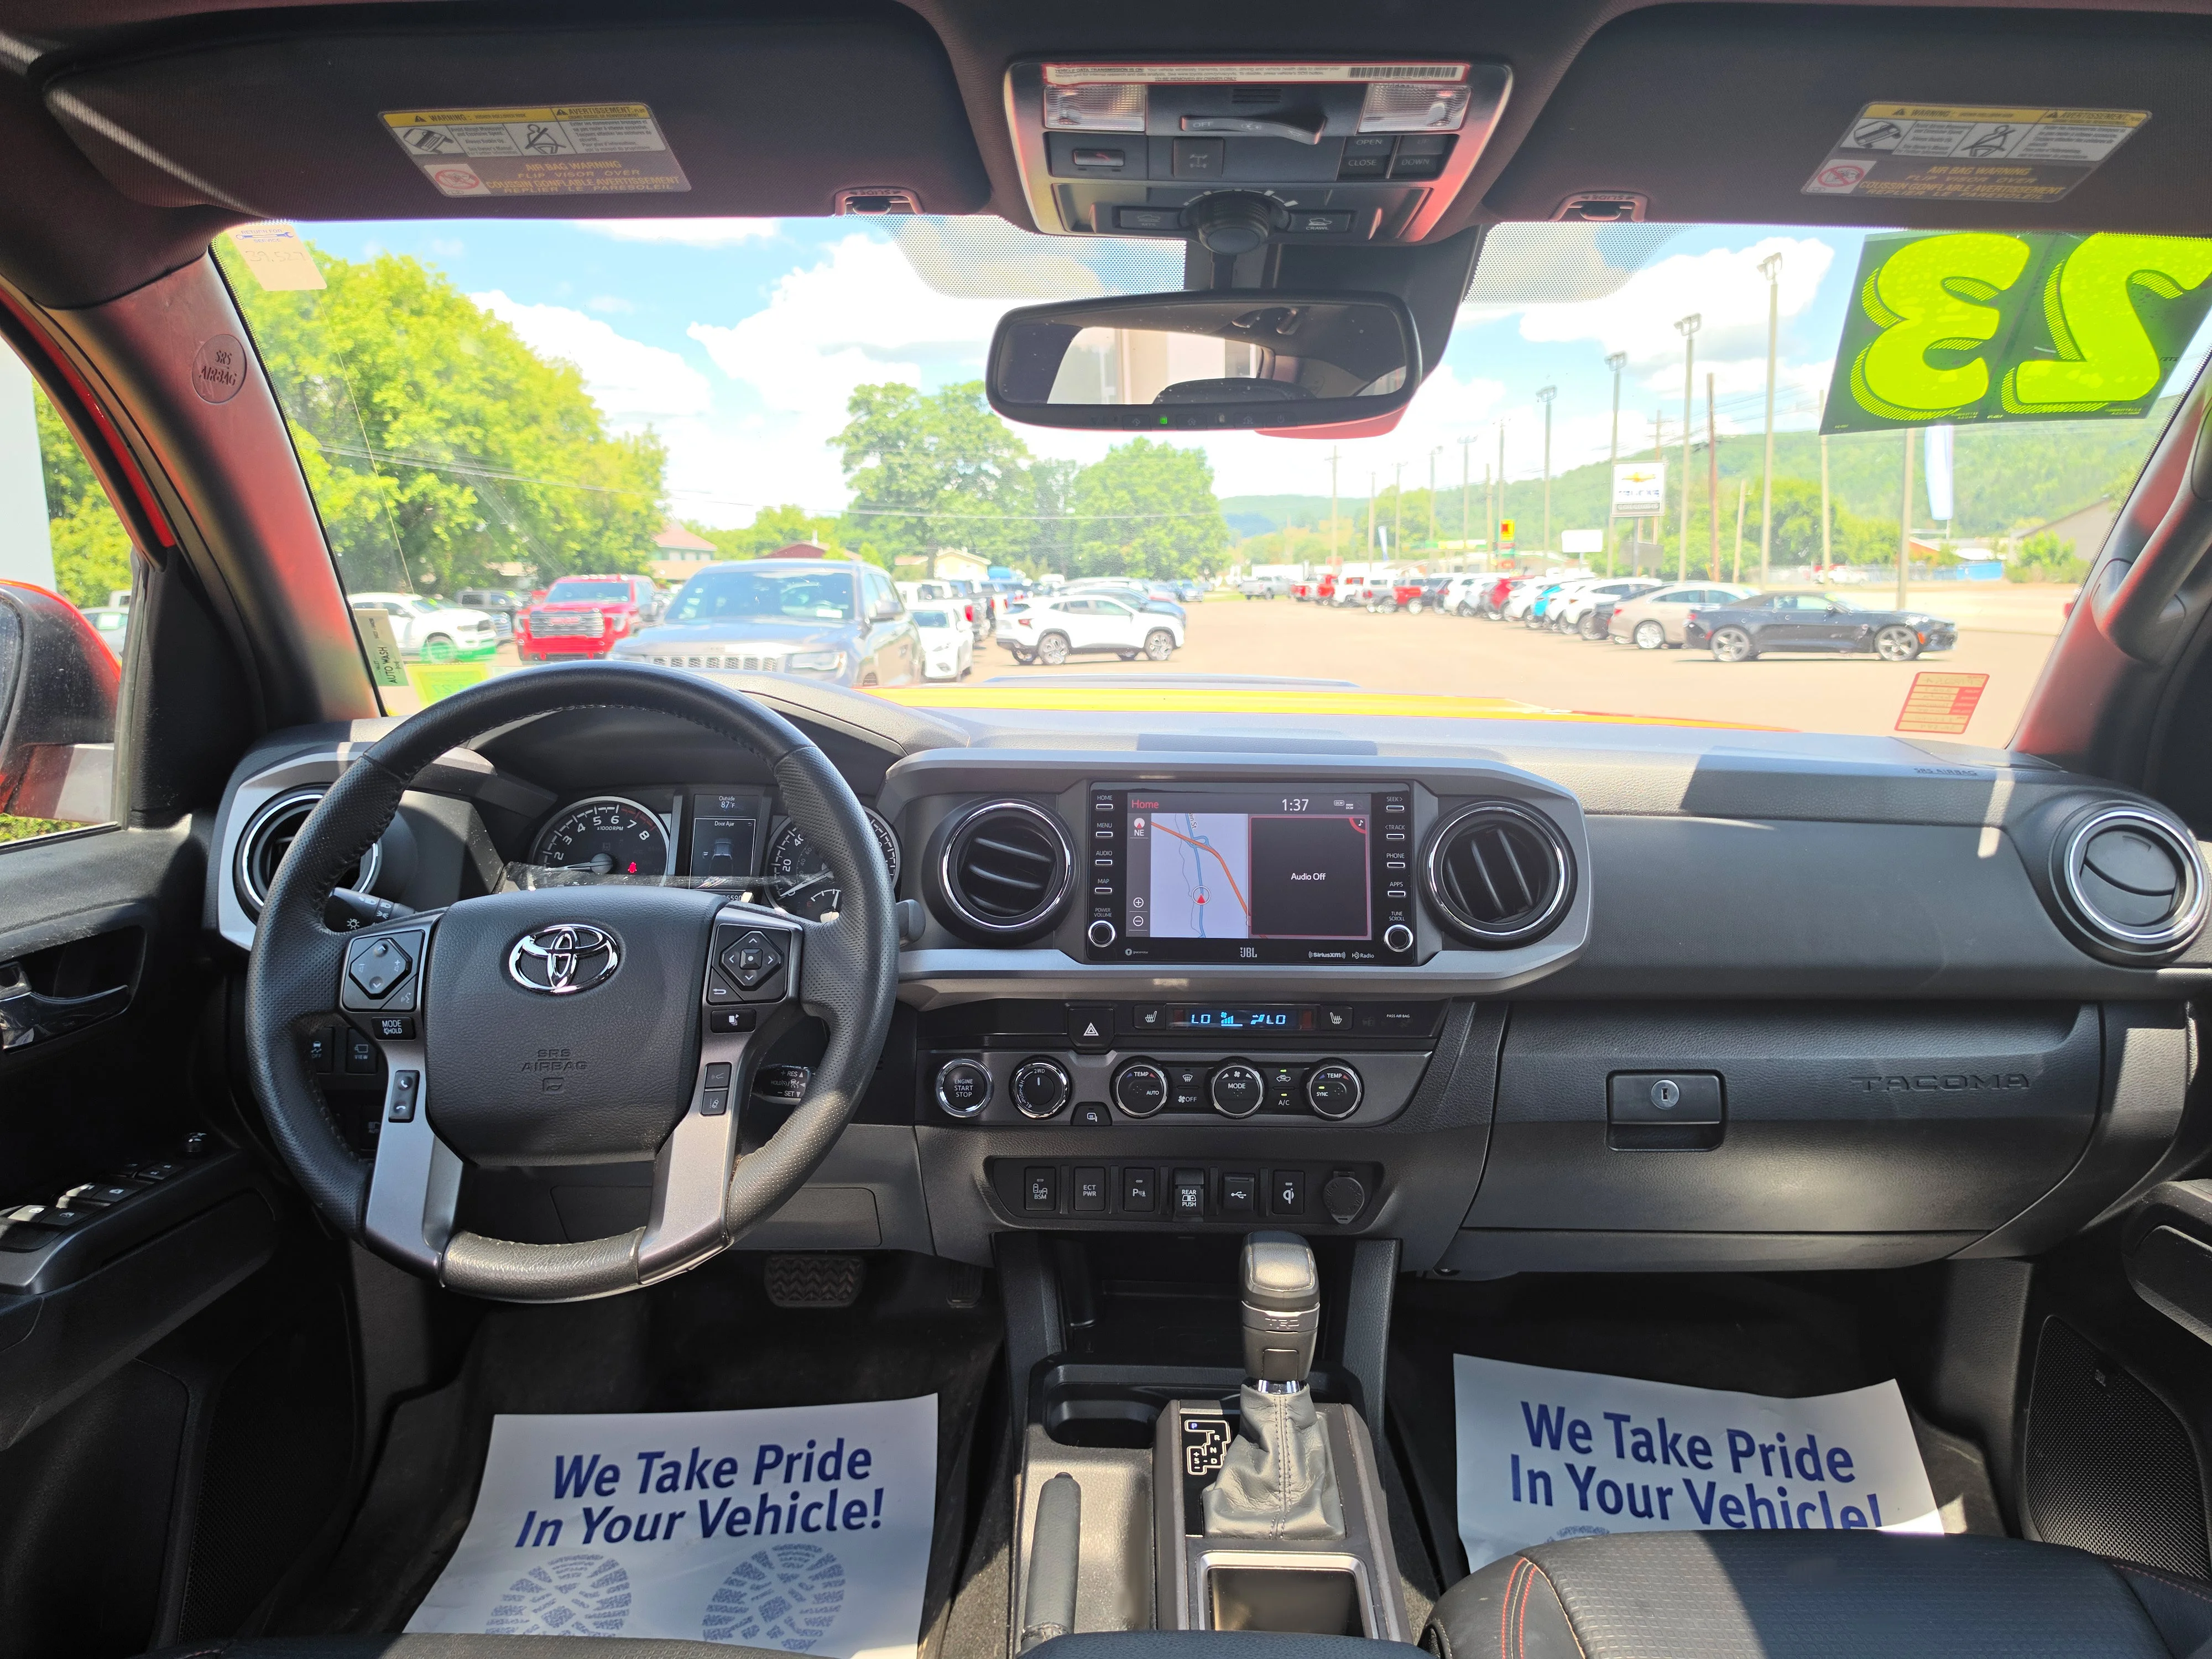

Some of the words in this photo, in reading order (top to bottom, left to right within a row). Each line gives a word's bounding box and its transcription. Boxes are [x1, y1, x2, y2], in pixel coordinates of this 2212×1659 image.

[568, 161, 622, 169] WARNING
[1927, 166, 1952, 175] AIR
[1975, 167, 2032, 175] WARNING
[534, 178, 596, 187] GONFLABLE
[596, 176, 679, 186] AVERTISSEMENT
[1859, 181, 1908, 191] COUSSIN
[1971, 184, 2067, 195] AVERTISSEMENT
[215, 350, 232, 365] SRS
[199, 366, 237, 387] AIRBAG
[378, 646, 390, 665] WASH
[384, 666, 398, 684] AUTO
[1131, 800, 1159, 808] Home
[1282, 799, 1309, 811] 1:37
[593, 816, 602, 826] 5
[611, 815, 619, 825] 6
[627, 820, 637, 828] 7
[577, 823, 586, 833] 4
[1191, 821, 1197, 830] St
[562, 836, 573, 845] 3
[639, 830, 650, 841] 8
[554, 852, 564, 860] 2
[782, 859, 792, 872] 20
[800, 858, 806, 867] 40
[1240, 947, 1257, 957] JBL
[1191, 1015, 1211, 1024] LO
[1266, 1015, 1286, 1025] LO
[538, 1049, 571, 1058] SRS
[1850, 1073, 2032, 1093] TACOMA
[1521, 1401, 1593, 1455] We
[1603, 1411, 1712, 1470] Take
[1726, 1428, 1855, 1484] Pride
[554, 1454, 620, 1501] We
[638, 1446, 739, 1494] Take
[753, 1438, 872, 1486] Pride
[1510, 1454, 1553, 1506] In
[1565, 1463, 1673, 1520] Your
[1683, 1478, 1882, 1530] Vehicle!
[515, 1511, 562, 1548] In
[582, 1505, 685, 1545] Your
[698, 1488, 886, 1538] Vehicle!
